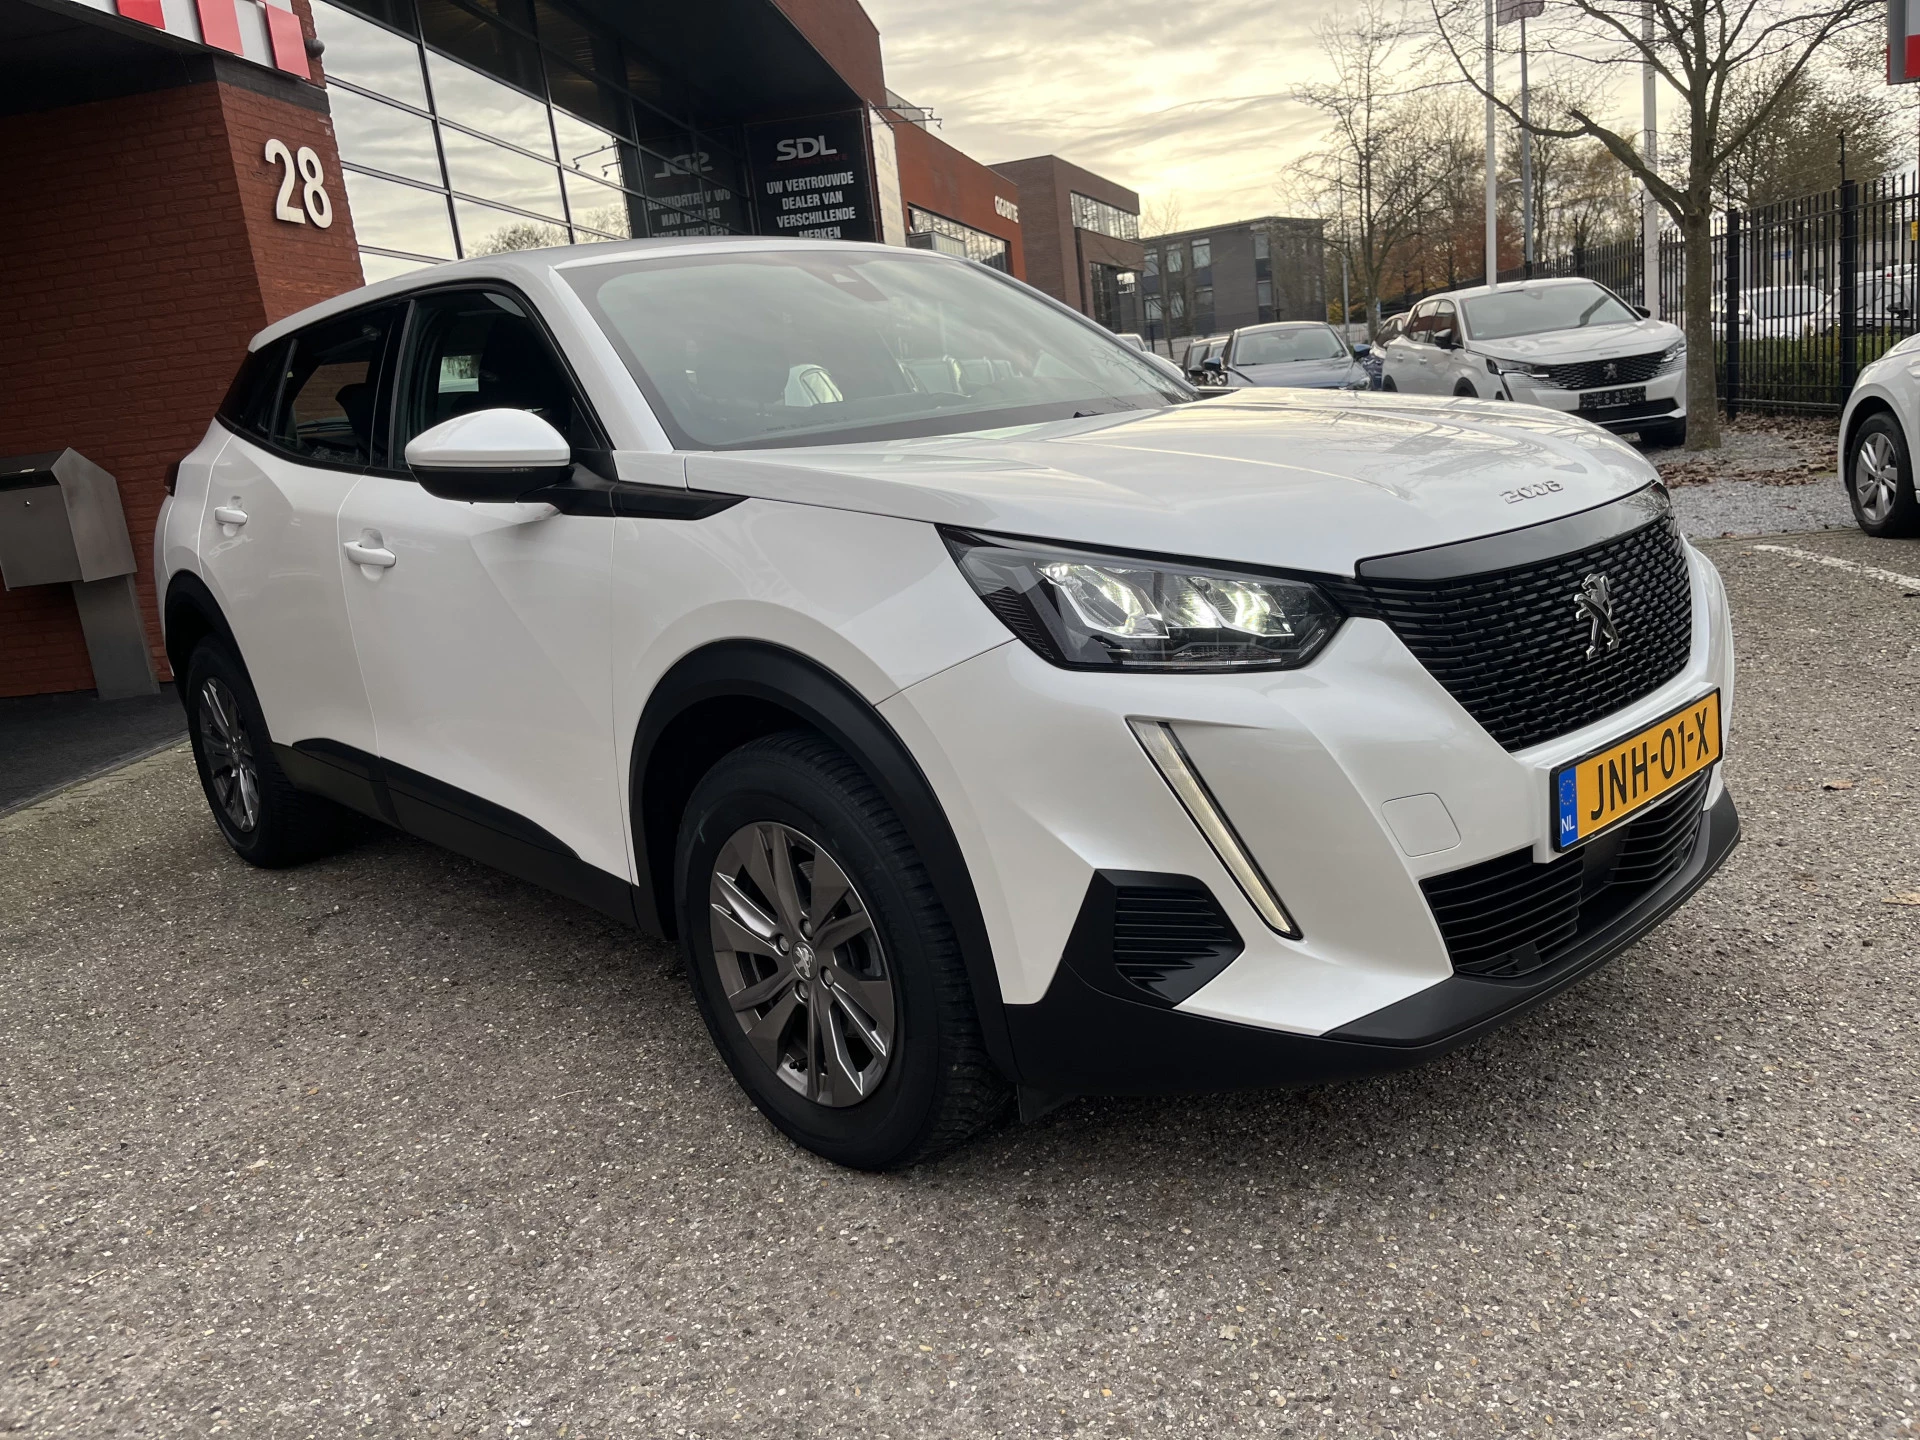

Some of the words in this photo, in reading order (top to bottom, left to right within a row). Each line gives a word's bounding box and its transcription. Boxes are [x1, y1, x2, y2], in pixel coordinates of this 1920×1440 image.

[776, 135, 837, 161] SDL
[265, 138, 332, 228] 28
[766, 181, 783, 195] UW
[785, 171, 854, 192] VERTROUWDE
[782, 193, 820, 210] DEALER
[822, 190, 843, 205] VAN
[776, 206, 856, 228] VERSCHILLENDE
[799, 226, 841, 239] MERKEN
[1561, 816, 1575, 834] NL
[1591, 707, 1709, 821] JNH-01-X
